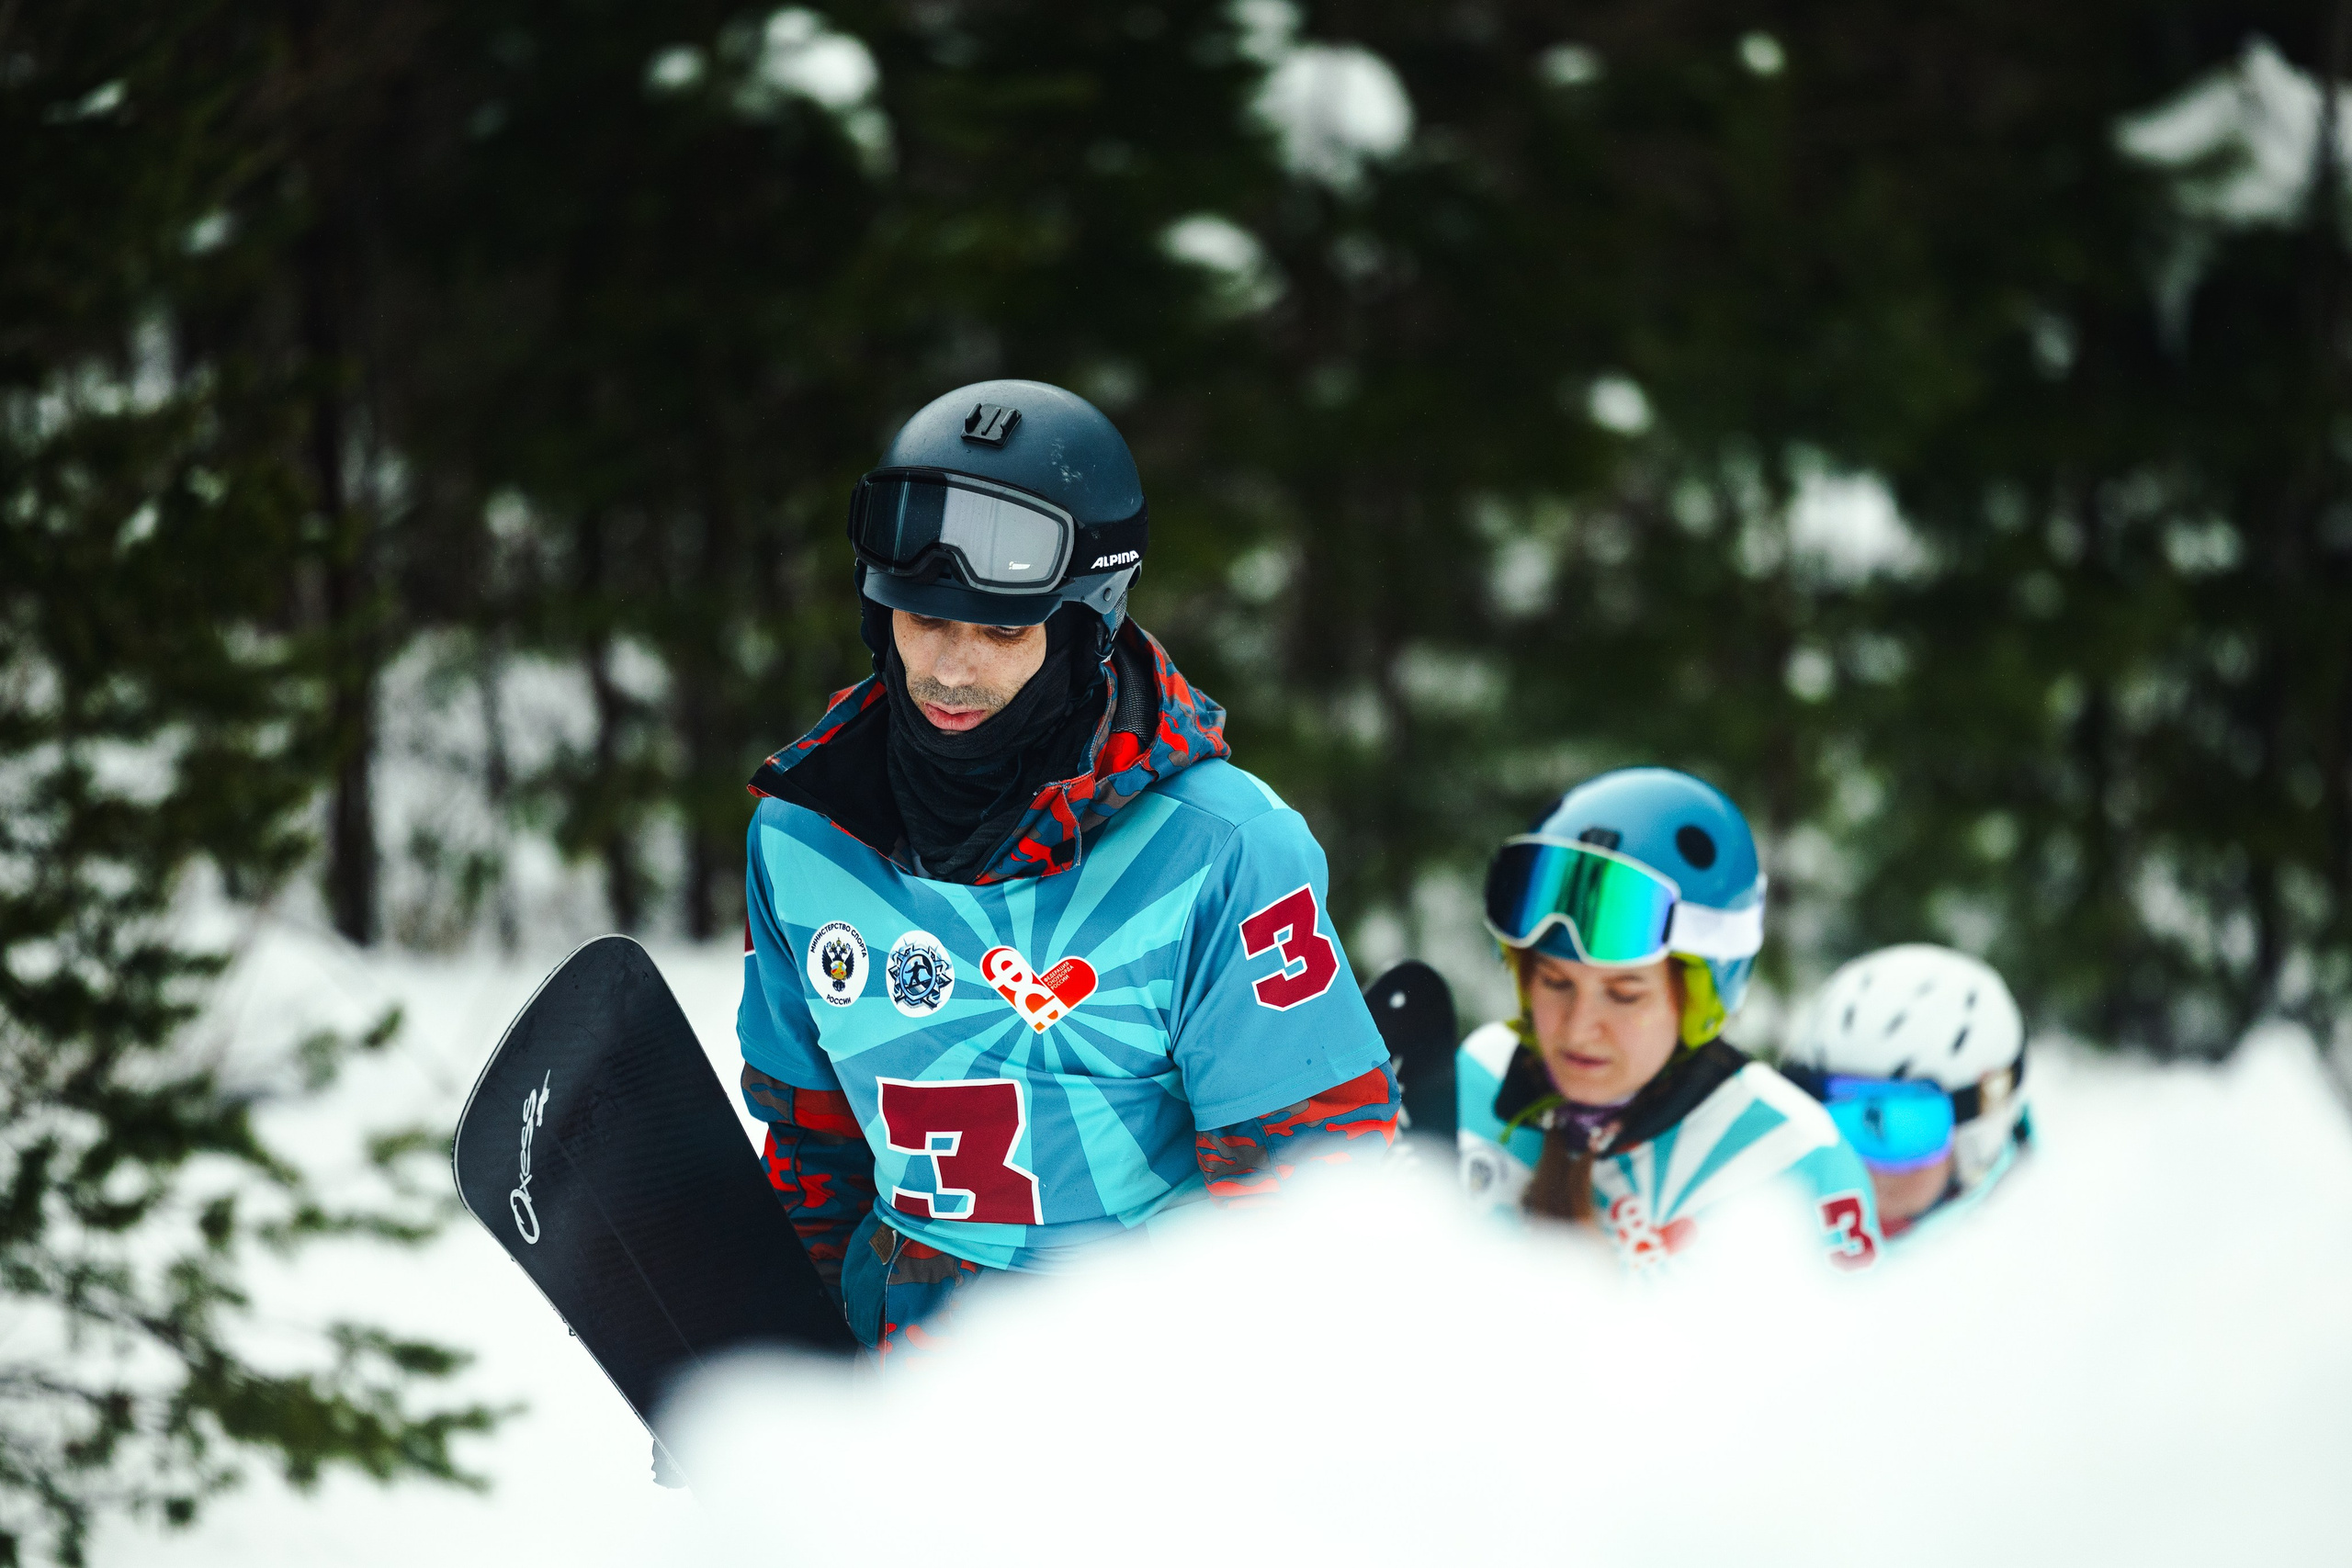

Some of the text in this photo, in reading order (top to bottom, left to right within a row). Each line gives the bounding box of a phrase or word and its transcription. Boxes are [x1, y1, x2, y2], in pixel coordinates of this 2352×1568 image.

[1091, 550, 1139, 569] ALPINA
[810, 922, 867, 958] МИНИСТЕРСТВО СПОРТА
[1238, 883, 1340, 1011] 3
[827, 994, 852, 1006] РОССИИ
[1050, 975, 1070, 990] РОССИИ
[876, 1076, 1045, 1225] 3
[1817, 1190, 1877, 1271] 3
